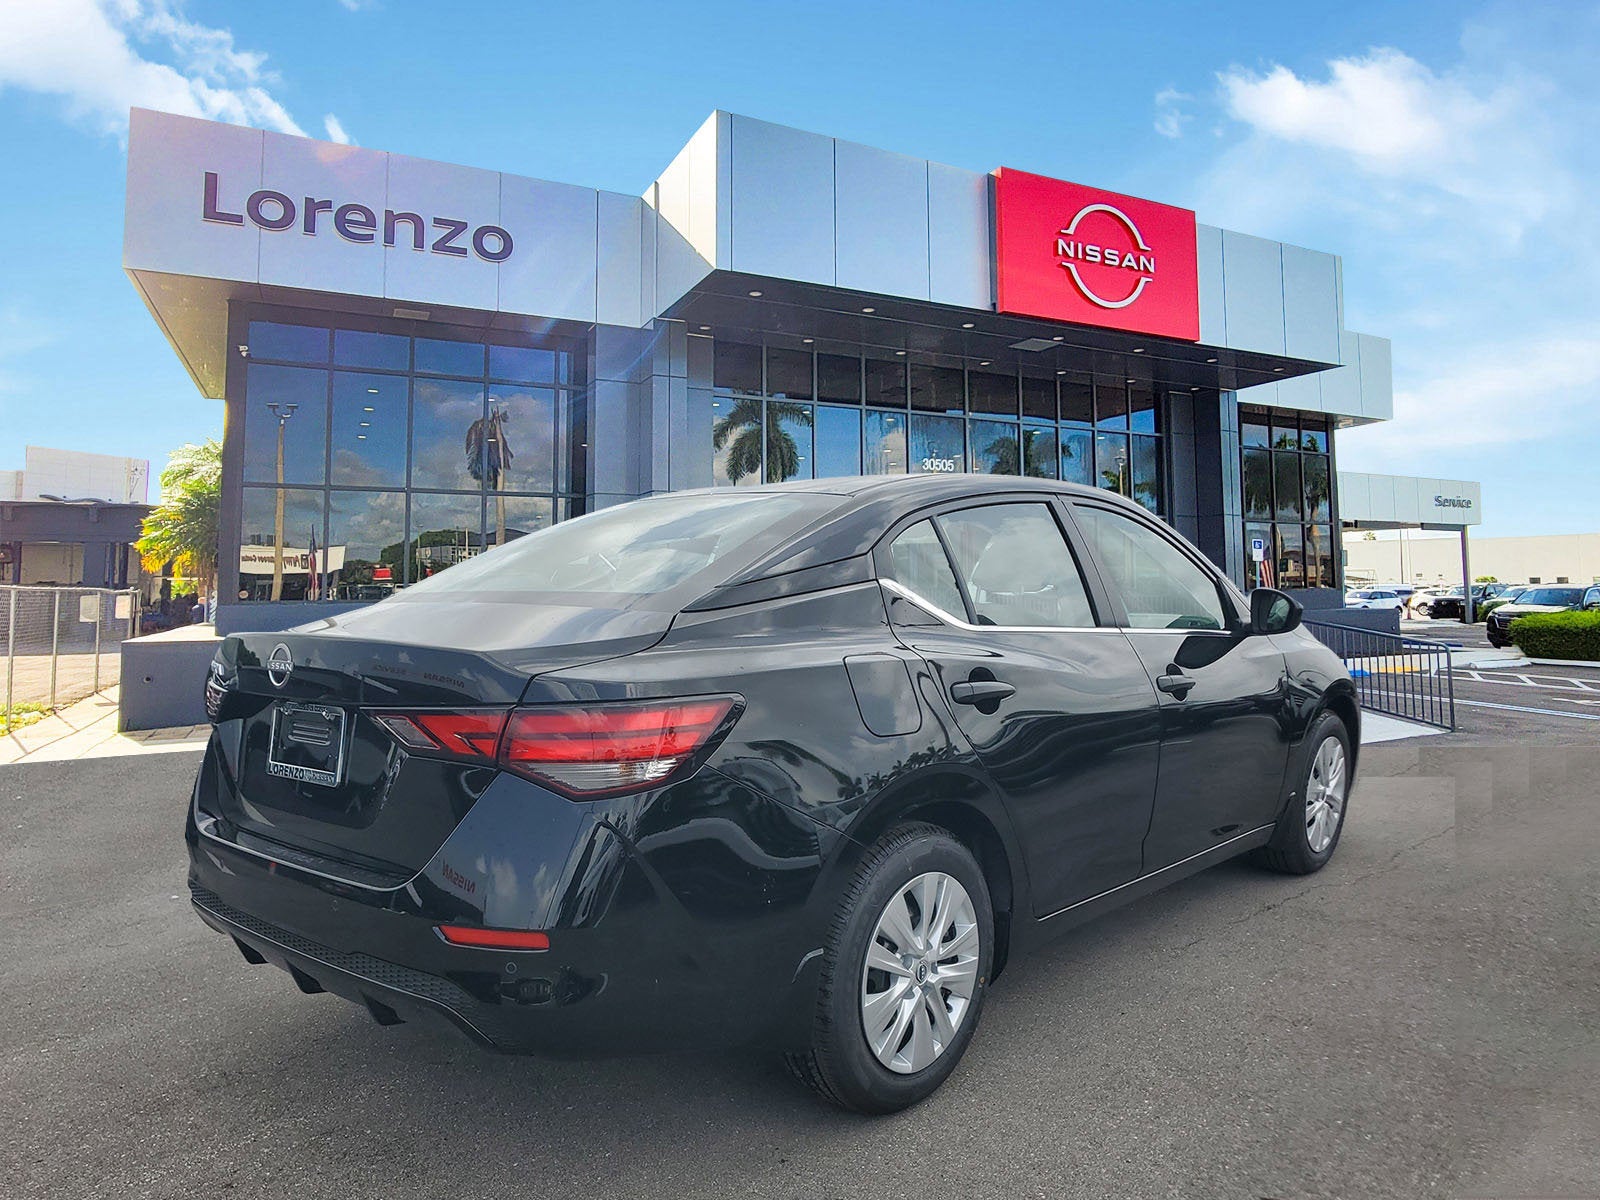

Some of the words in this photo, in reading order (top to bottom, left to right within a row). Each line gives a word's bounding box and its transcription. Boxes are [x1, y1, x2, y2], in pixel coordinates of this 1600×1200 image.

[203, 171, 514, 263] Lorenzo
[1057, 238, 1155, 273] NISSAN
[922, 457, 955, 472] 30505
[1434, 495, 1472, 509] Service
[268, 763, 305, 780] LORENZO
